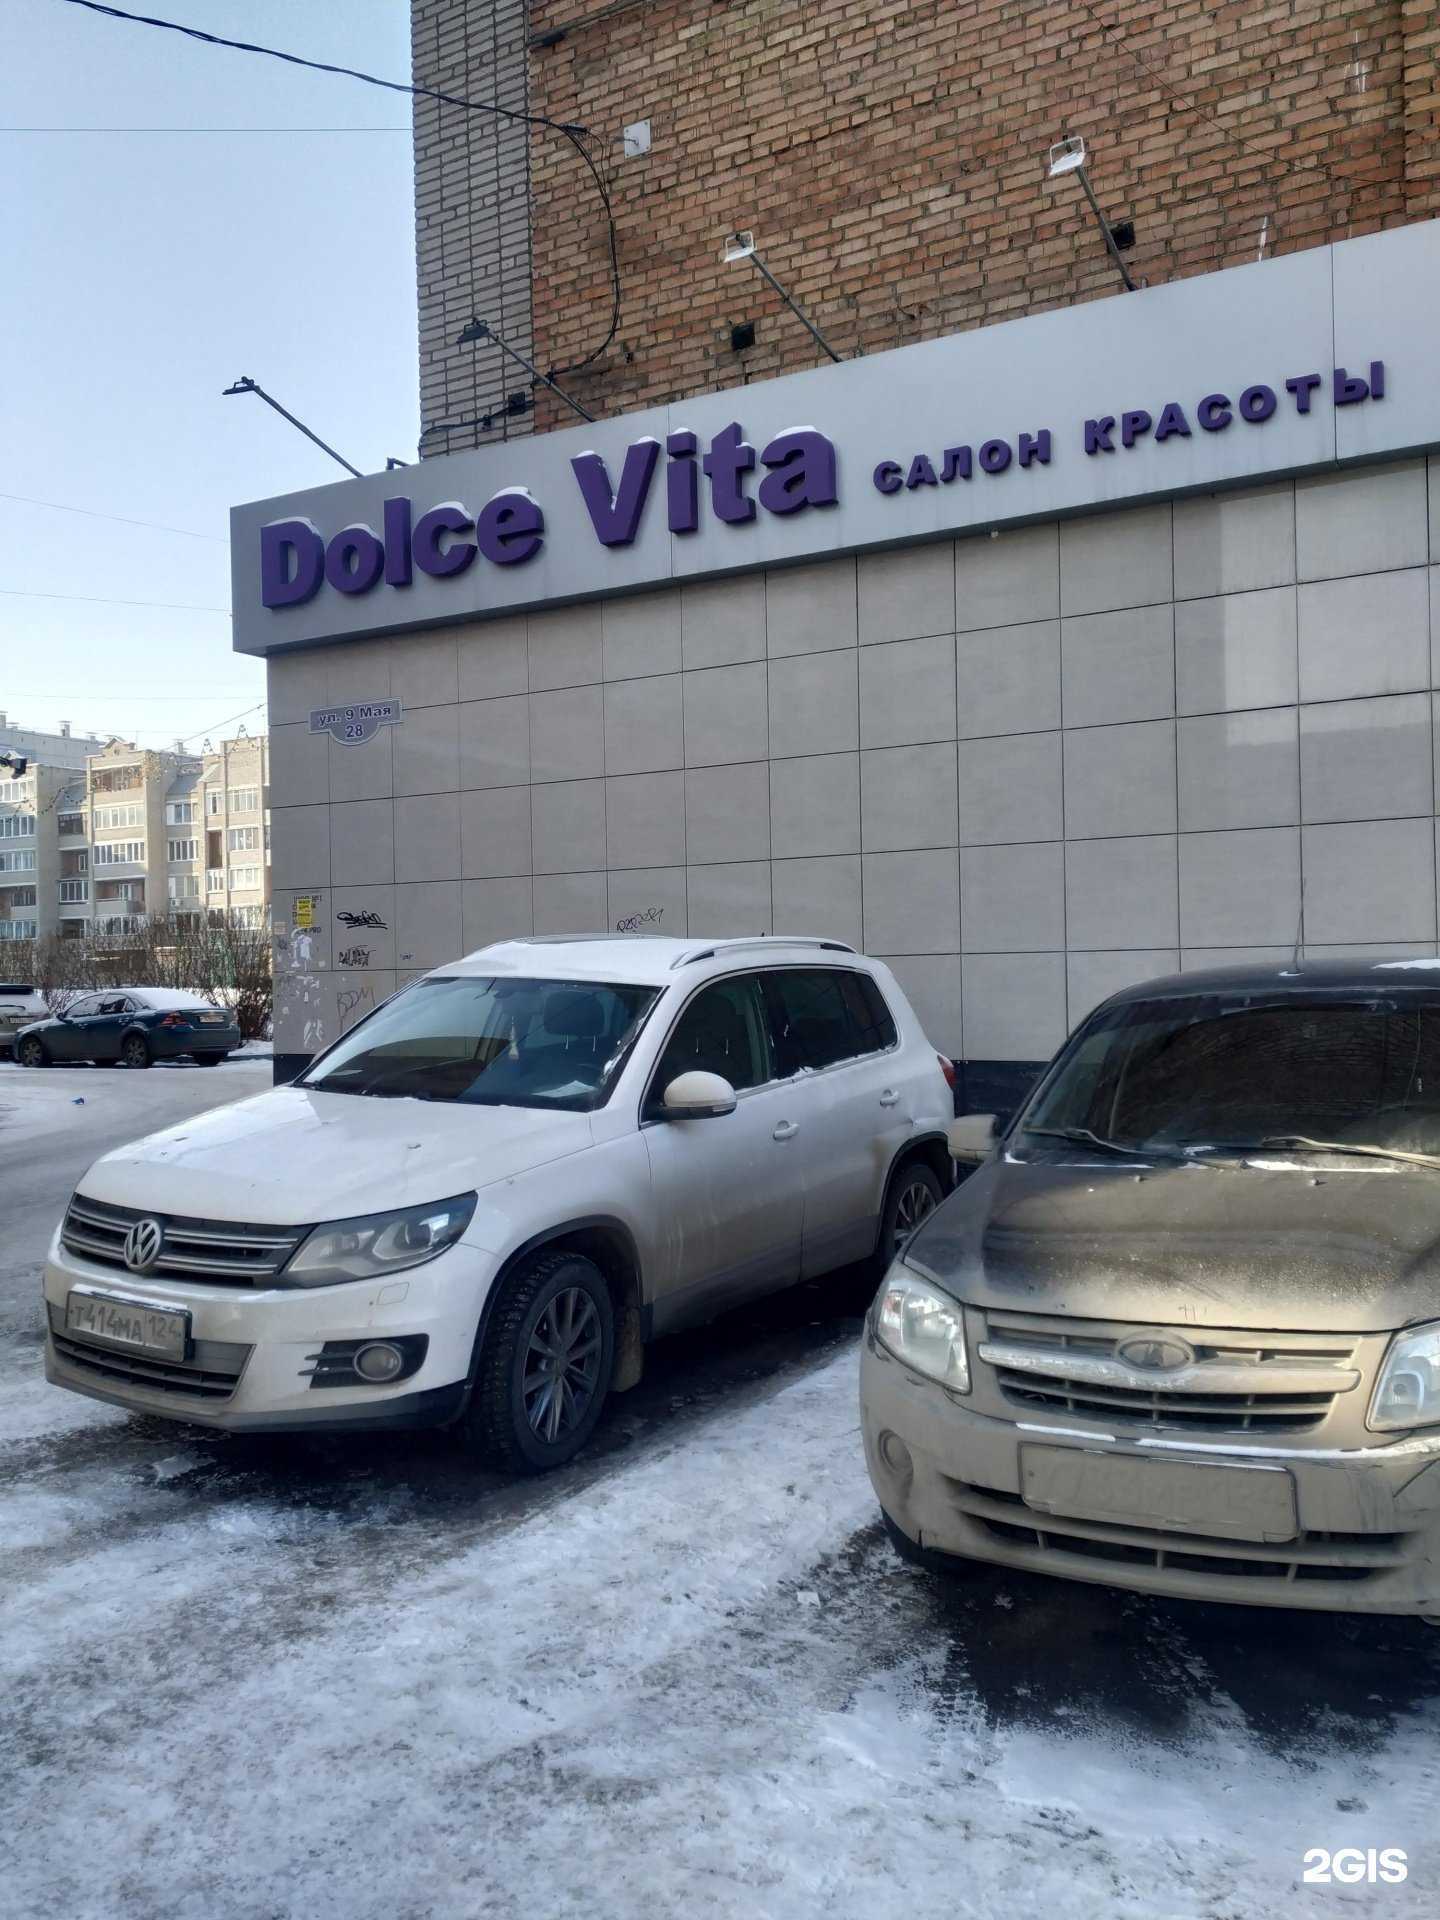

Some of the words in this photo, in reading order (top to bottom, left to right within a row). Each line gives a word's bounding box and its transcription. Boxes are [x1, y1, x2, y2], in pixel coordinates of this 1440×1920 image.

[873, 429, 1052, 495] САЛОН
[1084, 360, 1386, 456] КРАСОТЫ
[260, 489, 545, 610] Dolce
[570, 422, 840, 547] Vita
[319, 713, 341, 727] ул.
[345, 709, 355, 721] 9
[359, 706, 392, 719] Мая
[346, 725, 364, 738] 28
